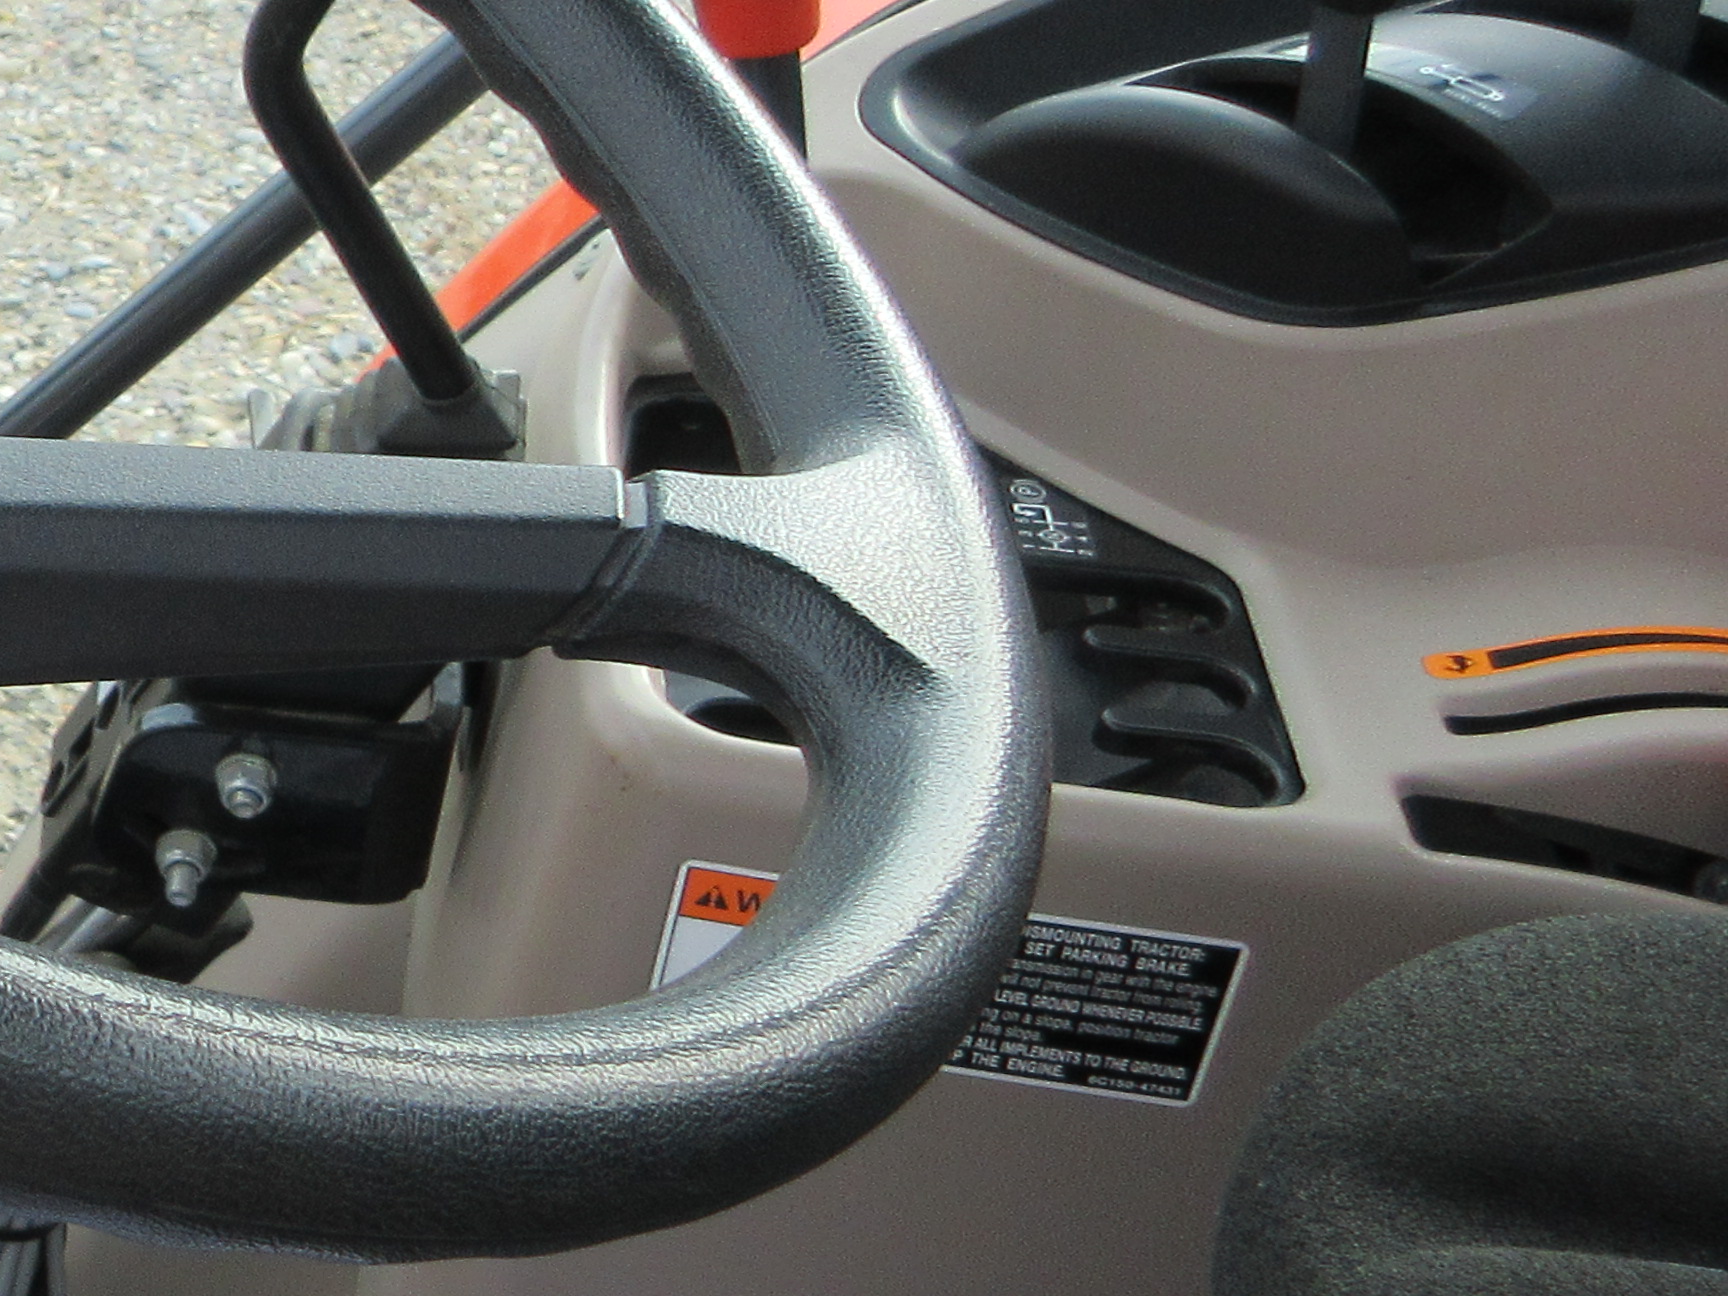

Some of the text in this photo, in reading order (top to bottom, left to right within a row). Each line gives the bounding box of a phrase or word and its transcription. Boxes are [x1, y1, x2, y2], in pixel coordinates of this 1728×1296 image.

[971, 1052, 1000, 1067] THE
[974, 1037, 997, 1052] ALL
[999, 1041, 1082, 1063] IMPLEMENTS
[1084, 1054, 1101, 1067] TO
[1104, 1056, 1129, 1072] THE
